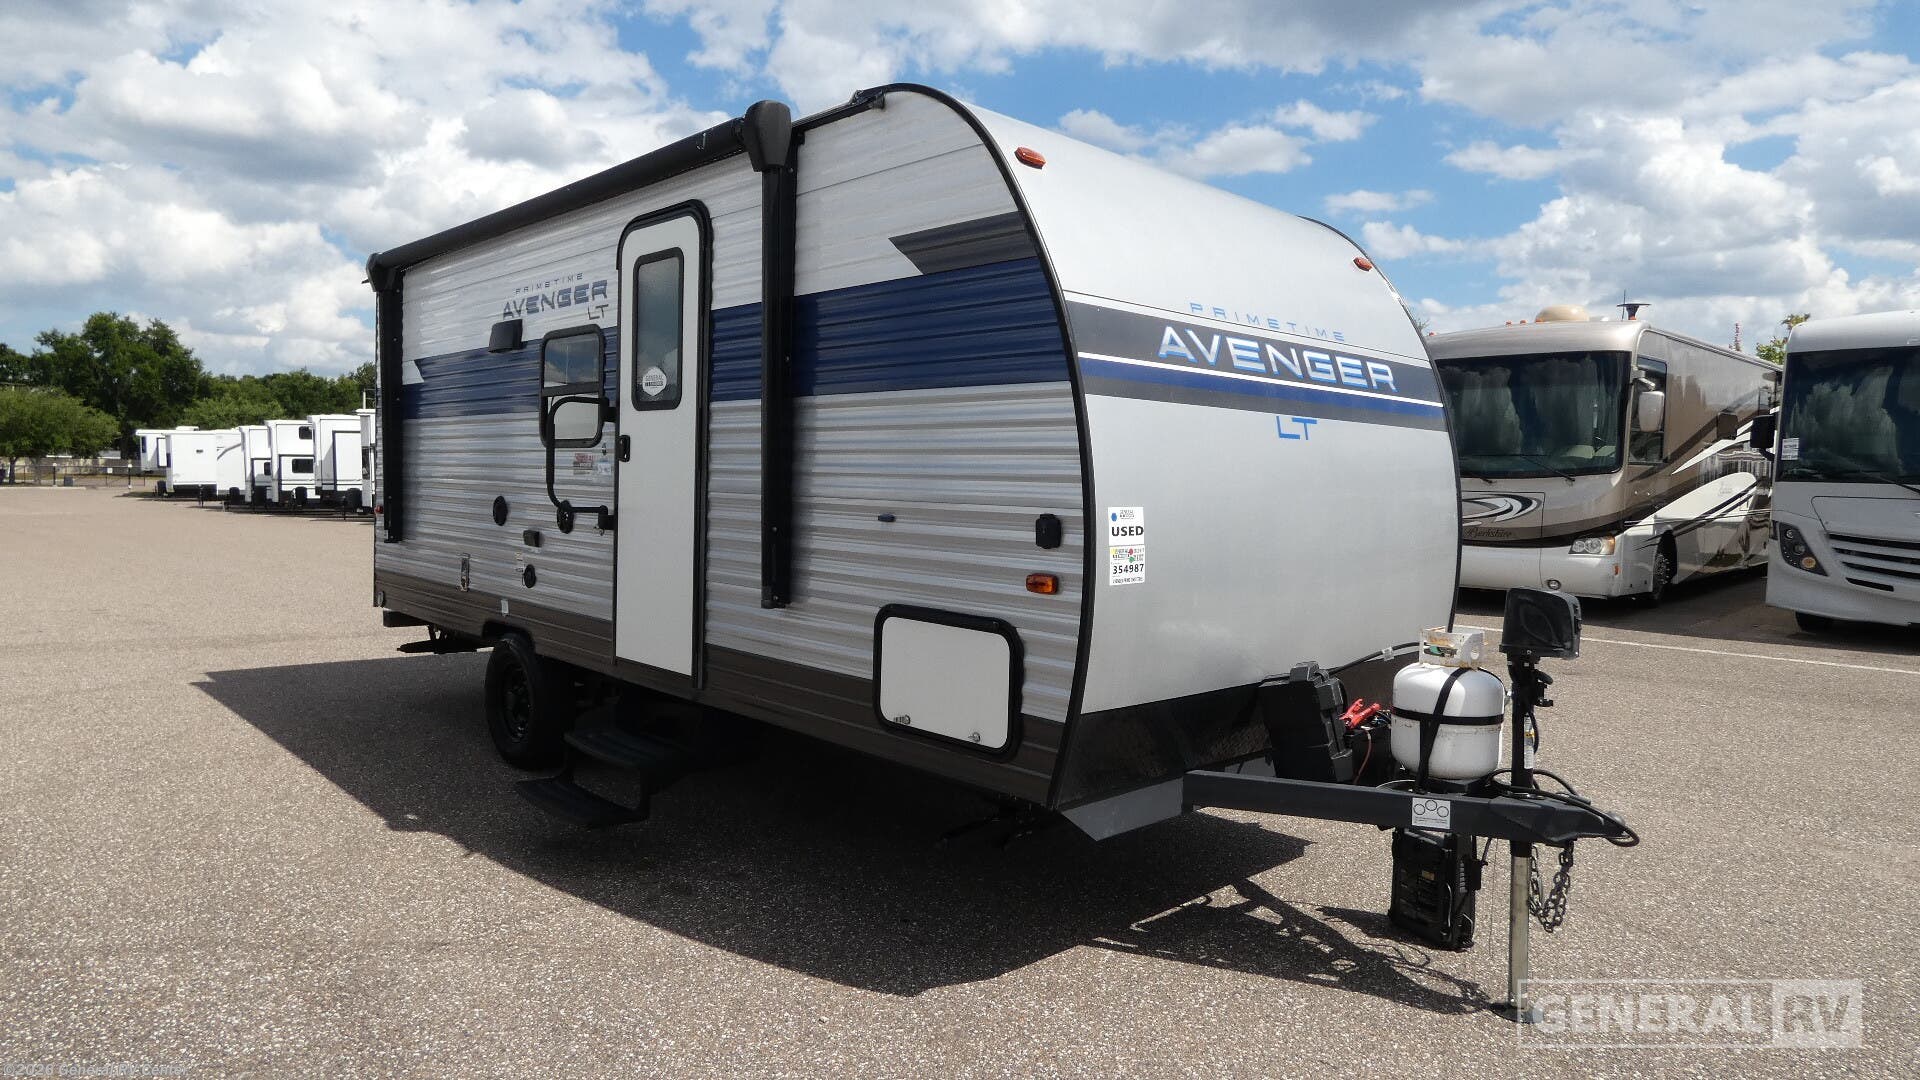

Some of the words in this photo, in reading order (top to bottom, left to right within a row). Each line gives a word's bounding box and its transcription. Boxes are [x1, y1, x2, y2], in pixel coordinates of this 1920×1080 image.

[515, 272, 583, 294] PRIMETIME
[503, 279, 608, 321] AVENGER
[587, 303, 609, 320] LT
[1190, 302, 1345, 342] PRIMETIME
[1157, 326, 1399, 393] AVENGER
[1276, 415, 1318, 441] LT
[1111, 525, 1144, 537] USED
[1112, 563, 1145, 575] 354987
